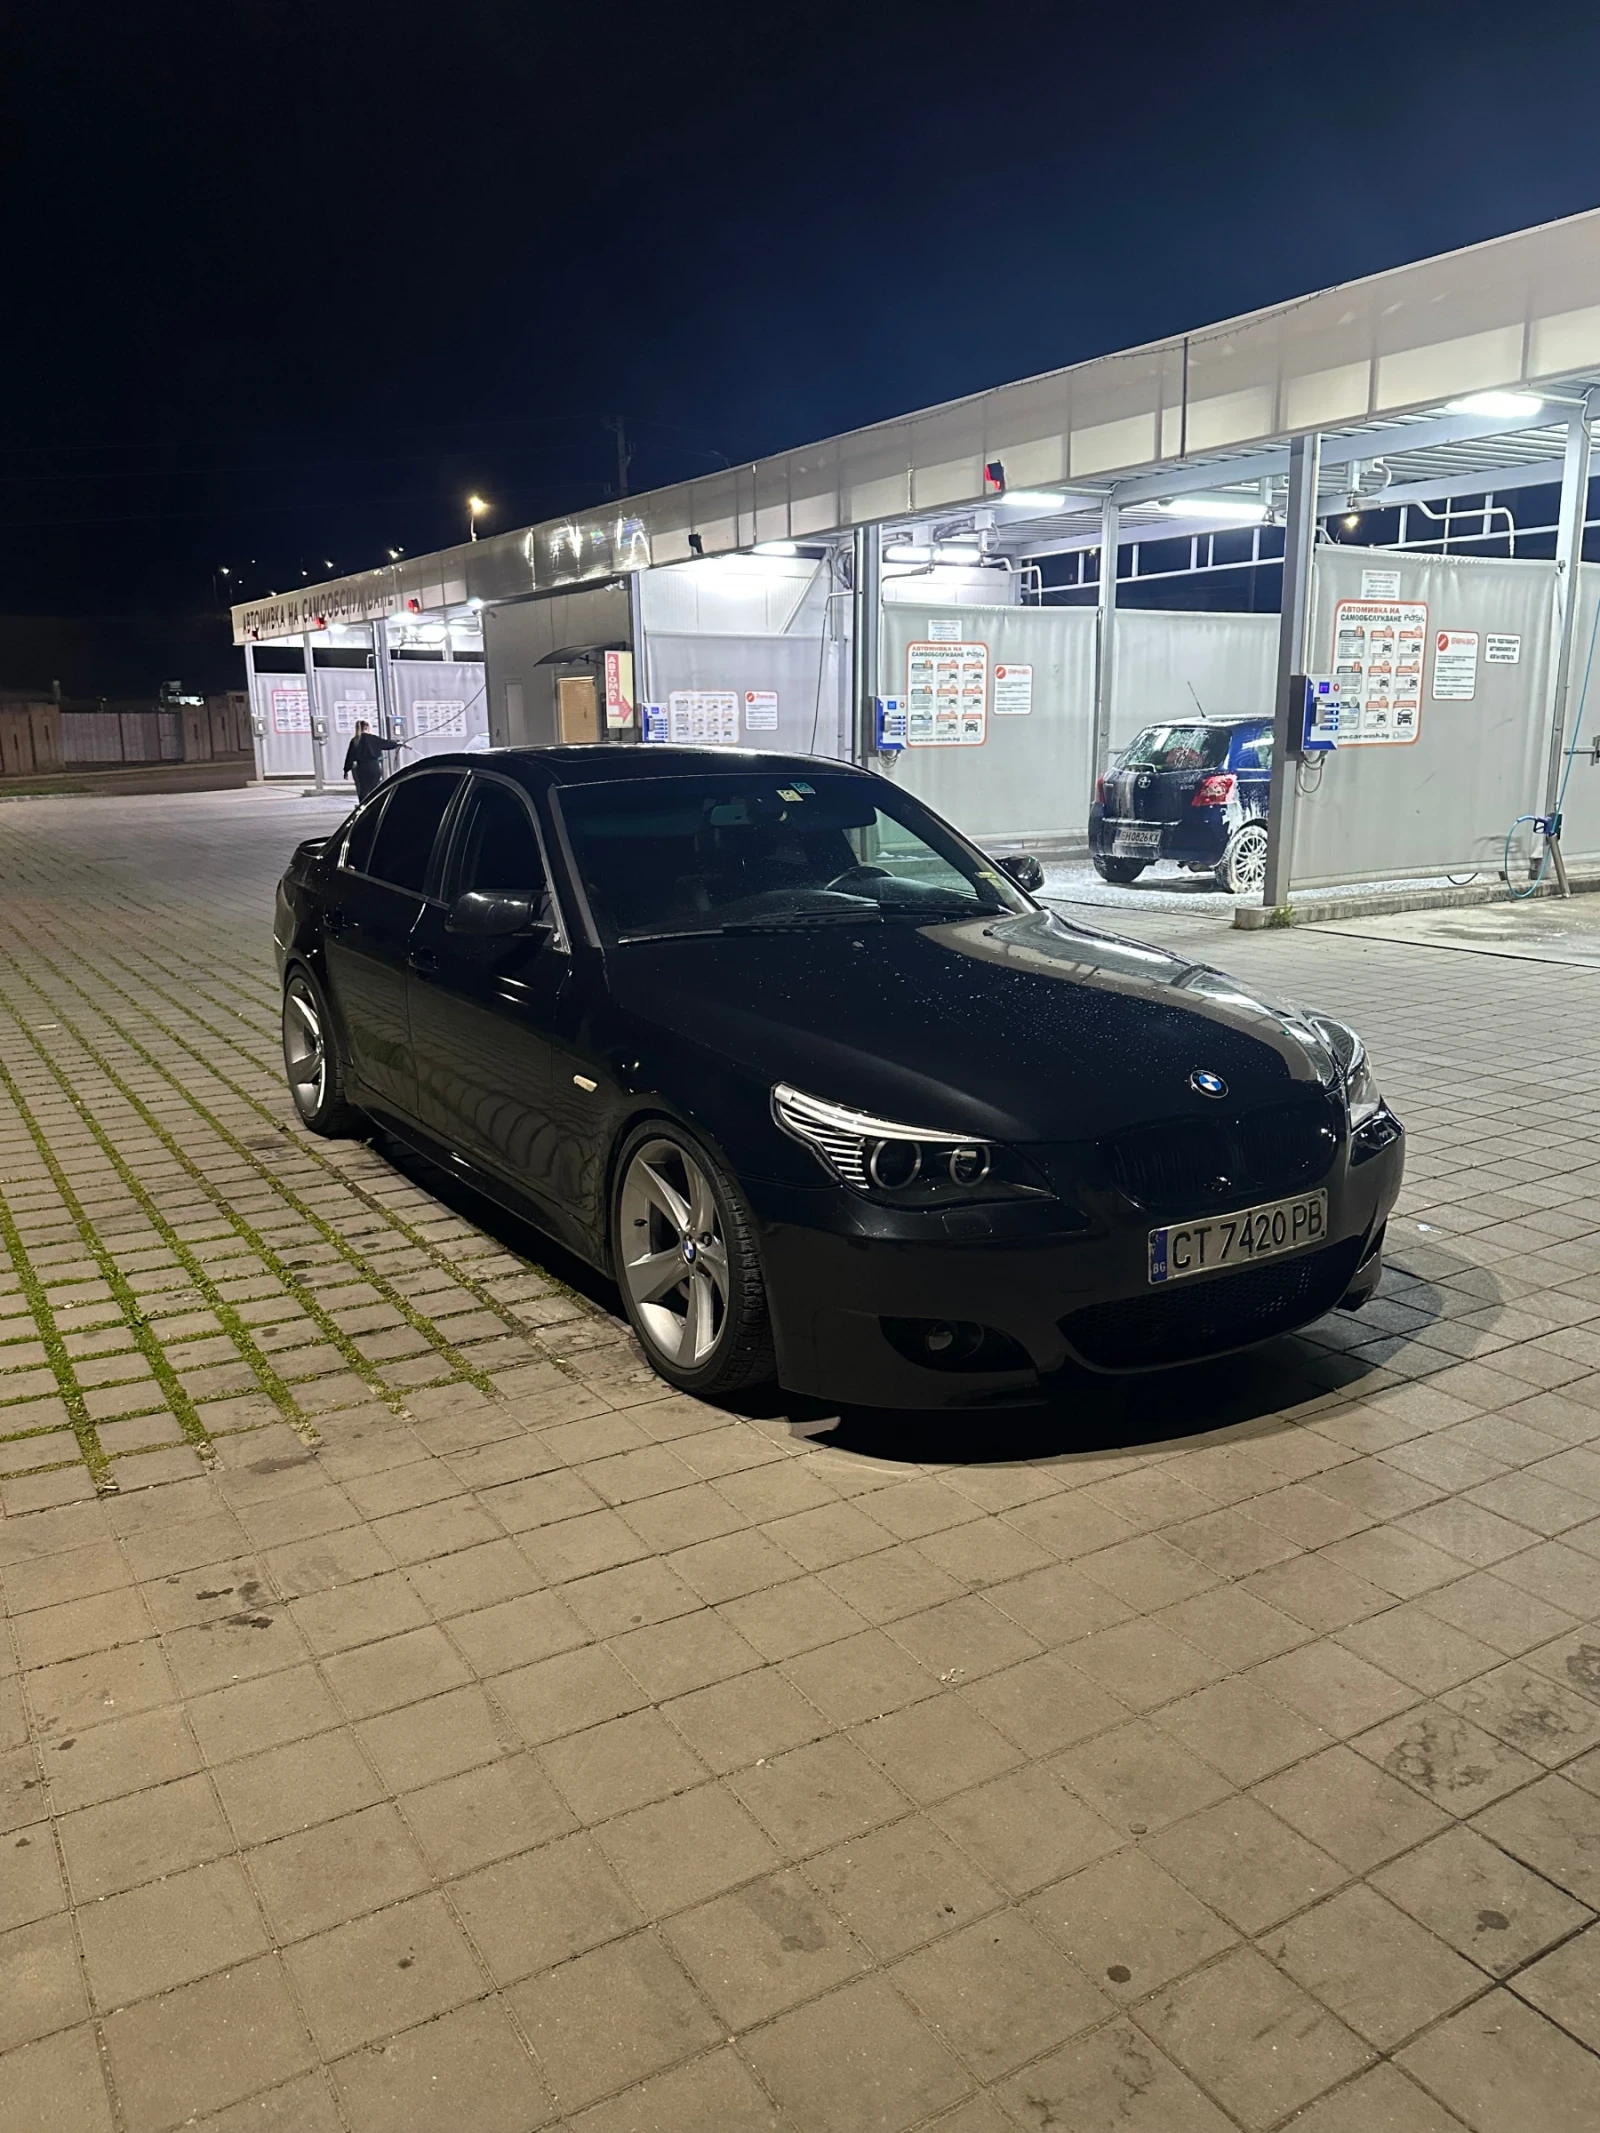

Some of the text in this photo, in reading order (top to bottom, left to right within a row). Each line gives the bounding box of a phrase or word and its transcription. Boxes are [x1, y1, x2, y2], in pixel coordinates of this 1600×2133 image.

[242, 604, 286, 634] АВТОМИВКА
[288, 601, 299, 626] НА
[1340, 614, 1402, 622] САМООБСЛУЖВАНЕ
[1341, 606, 1388, 614] АВТОМИВКА
[607, 656, 618, 703] АВТОМАТ
[1172, 1200, 1323, 1269] CT 7420 PB
[1152, 1261, 1167, 1275] BG
